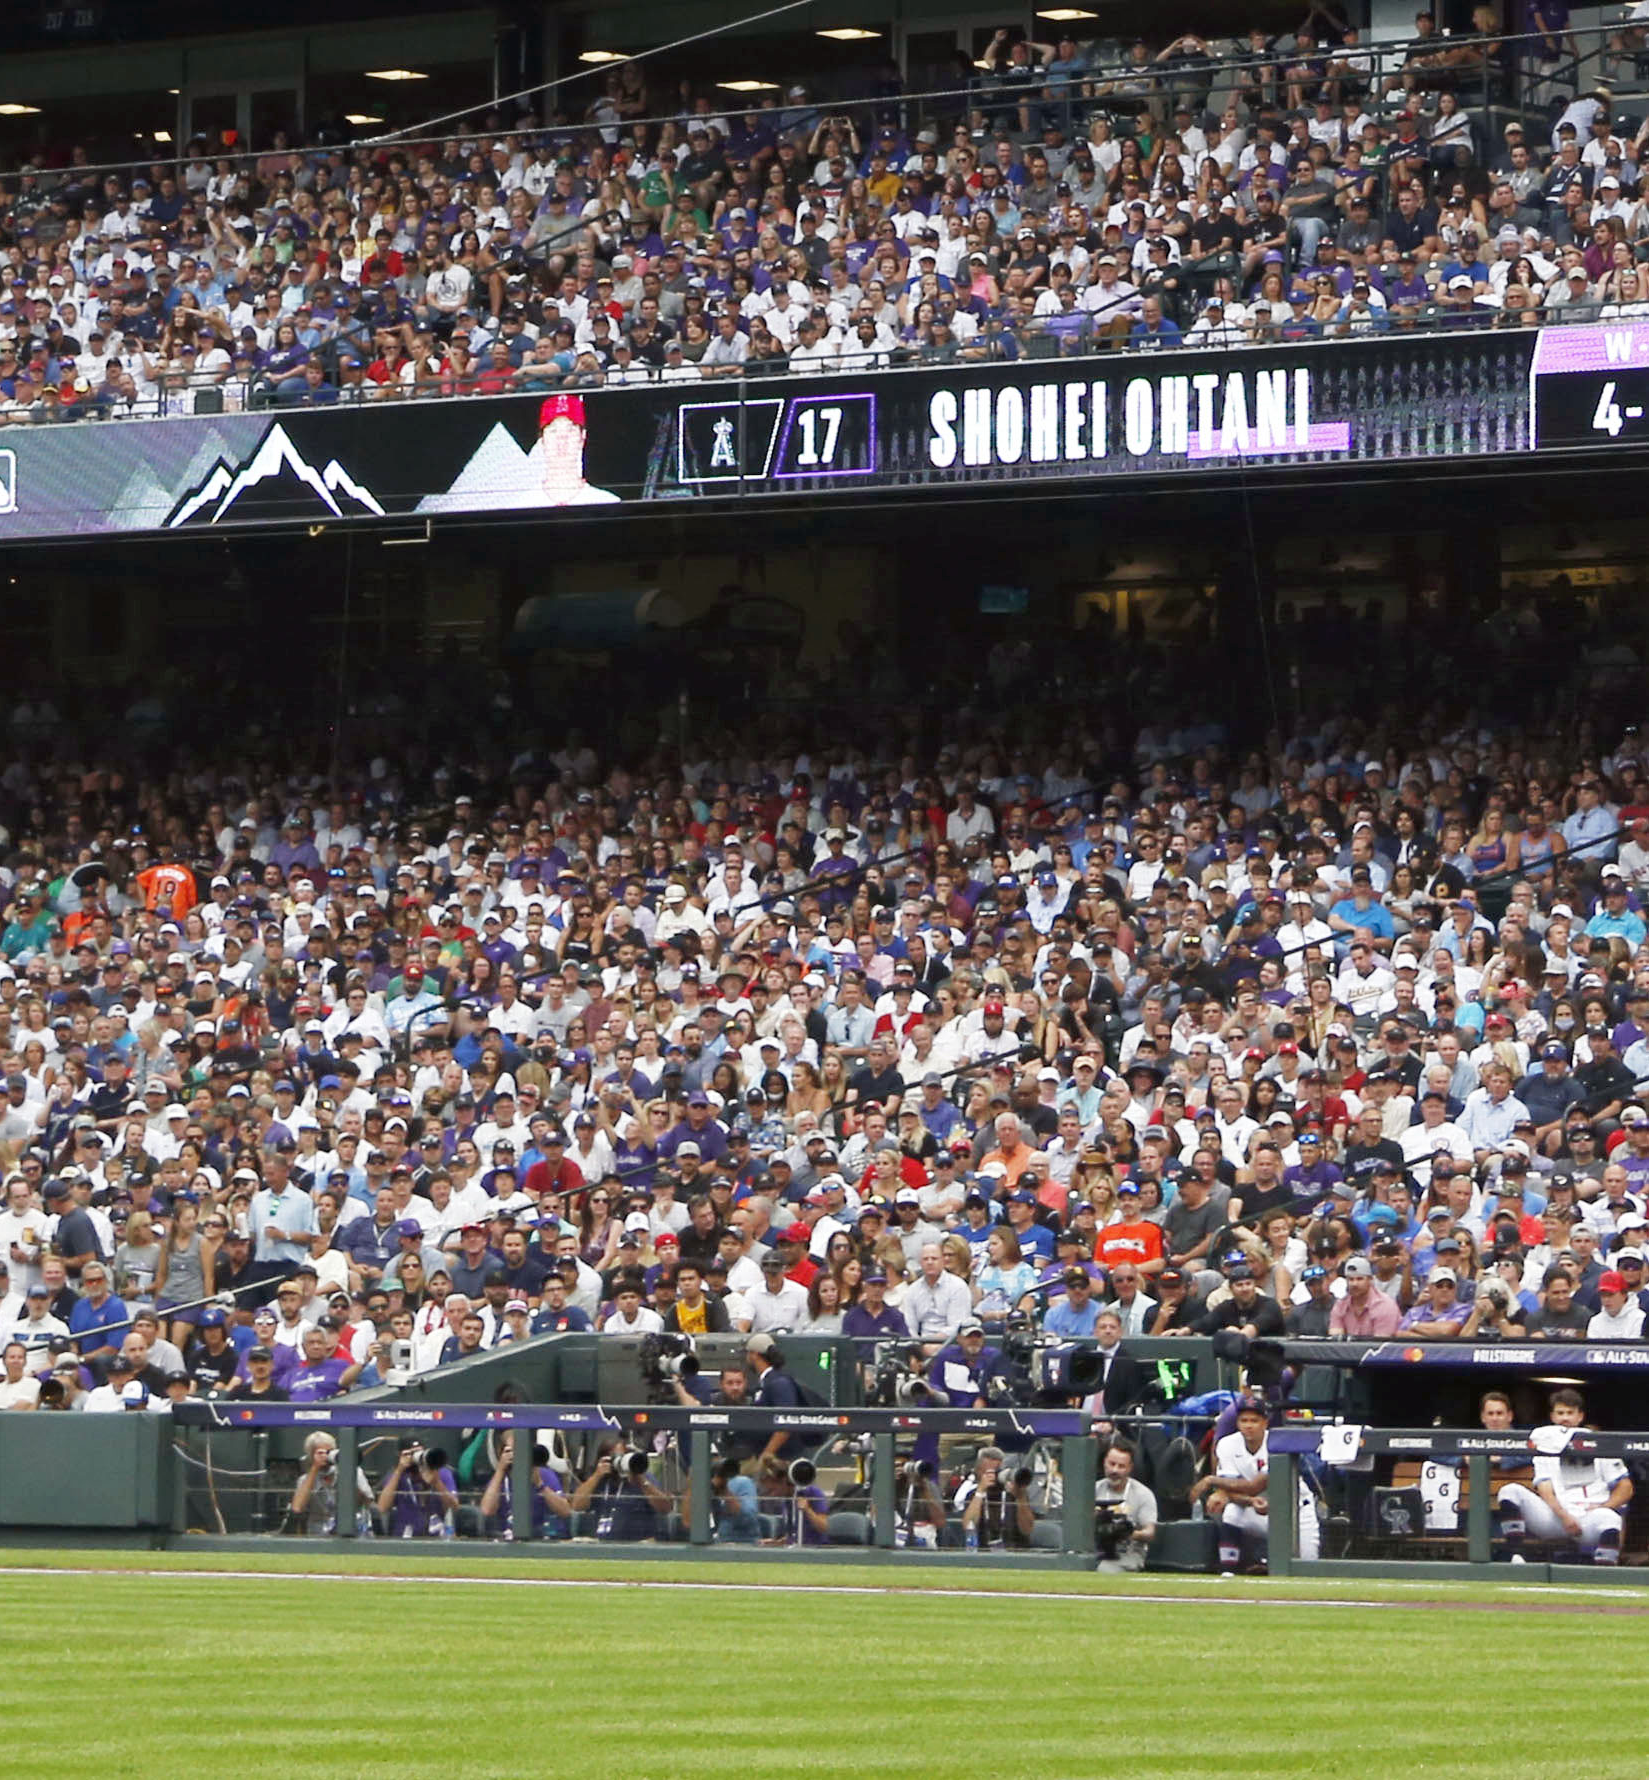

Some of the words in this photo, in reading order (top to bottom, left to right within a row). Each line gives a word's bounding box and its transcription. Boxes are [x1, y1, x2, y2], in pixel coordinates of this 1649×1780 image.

[1604, 330, 1634, 363] W
[797, 407, 843, 466] 17
[929, 381, 1108, 468] SHOHEI
[1125, 368, 1310, 456] OHTANI
